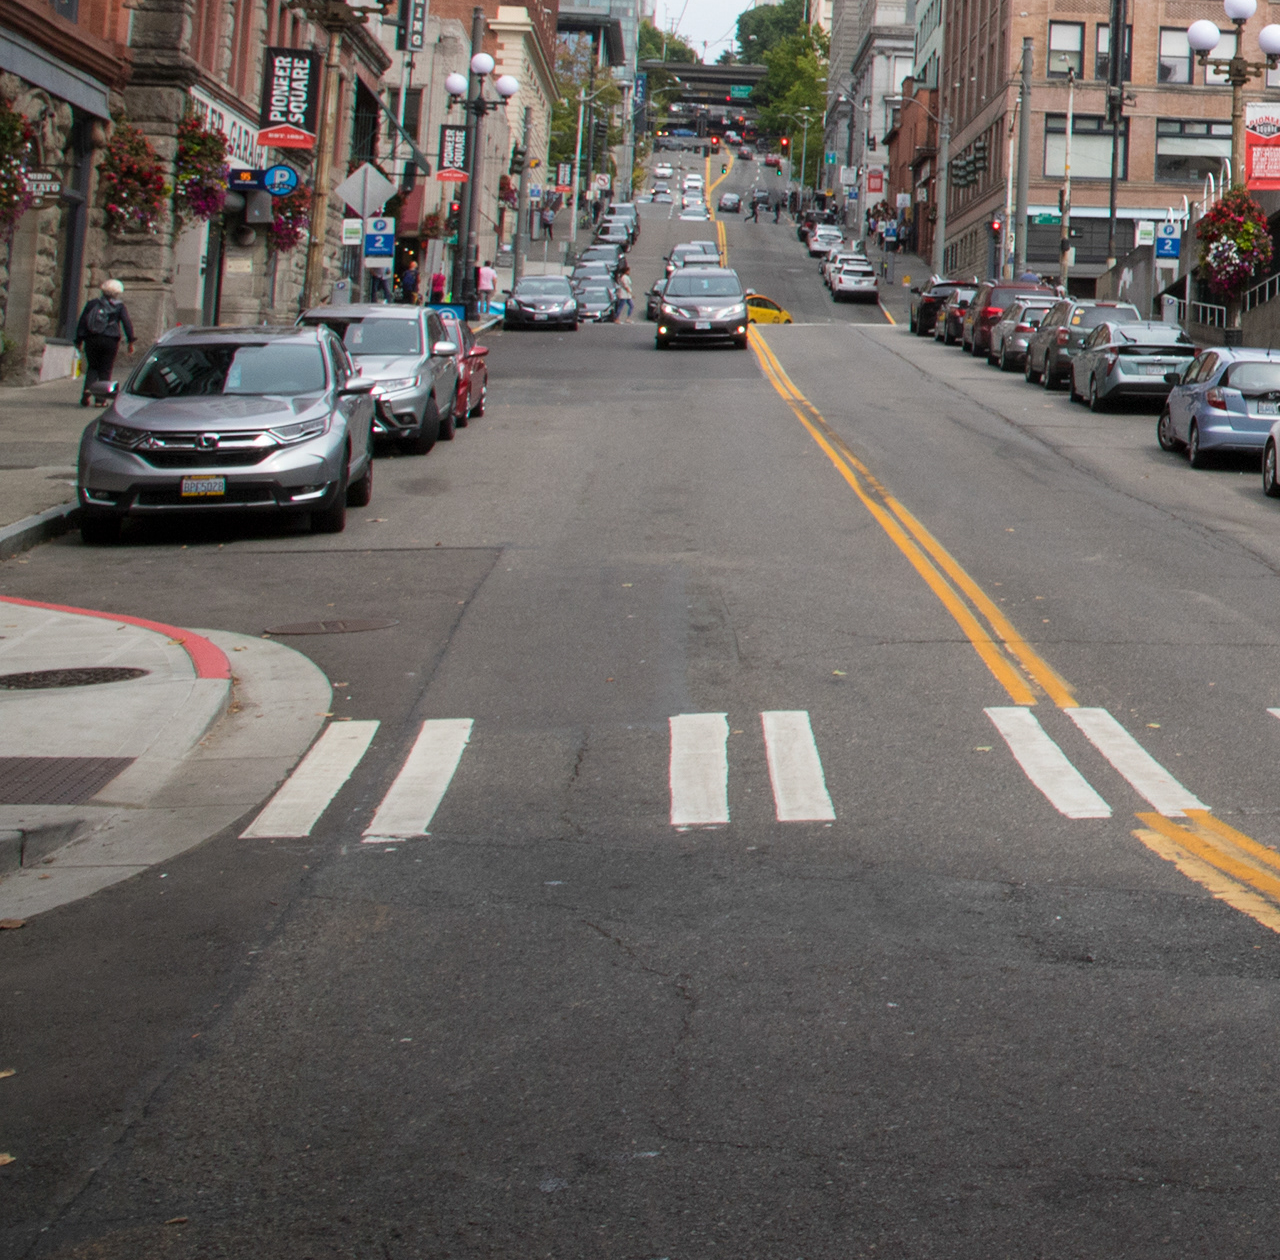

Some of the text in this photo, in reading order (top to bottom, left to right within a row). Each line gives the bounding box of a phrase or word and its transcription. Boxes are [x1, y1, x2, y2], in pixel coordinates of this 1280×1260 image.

[269, 55, 292, 122] PIONEER
[288, 57, 311, 124] SQUARE
[443, 128, 455, 168] PIONEER
[453, 129, 466, 168] SQUARE
[374, 236, 385, 247] 2
[1163, 239, 1173, 250] 2
